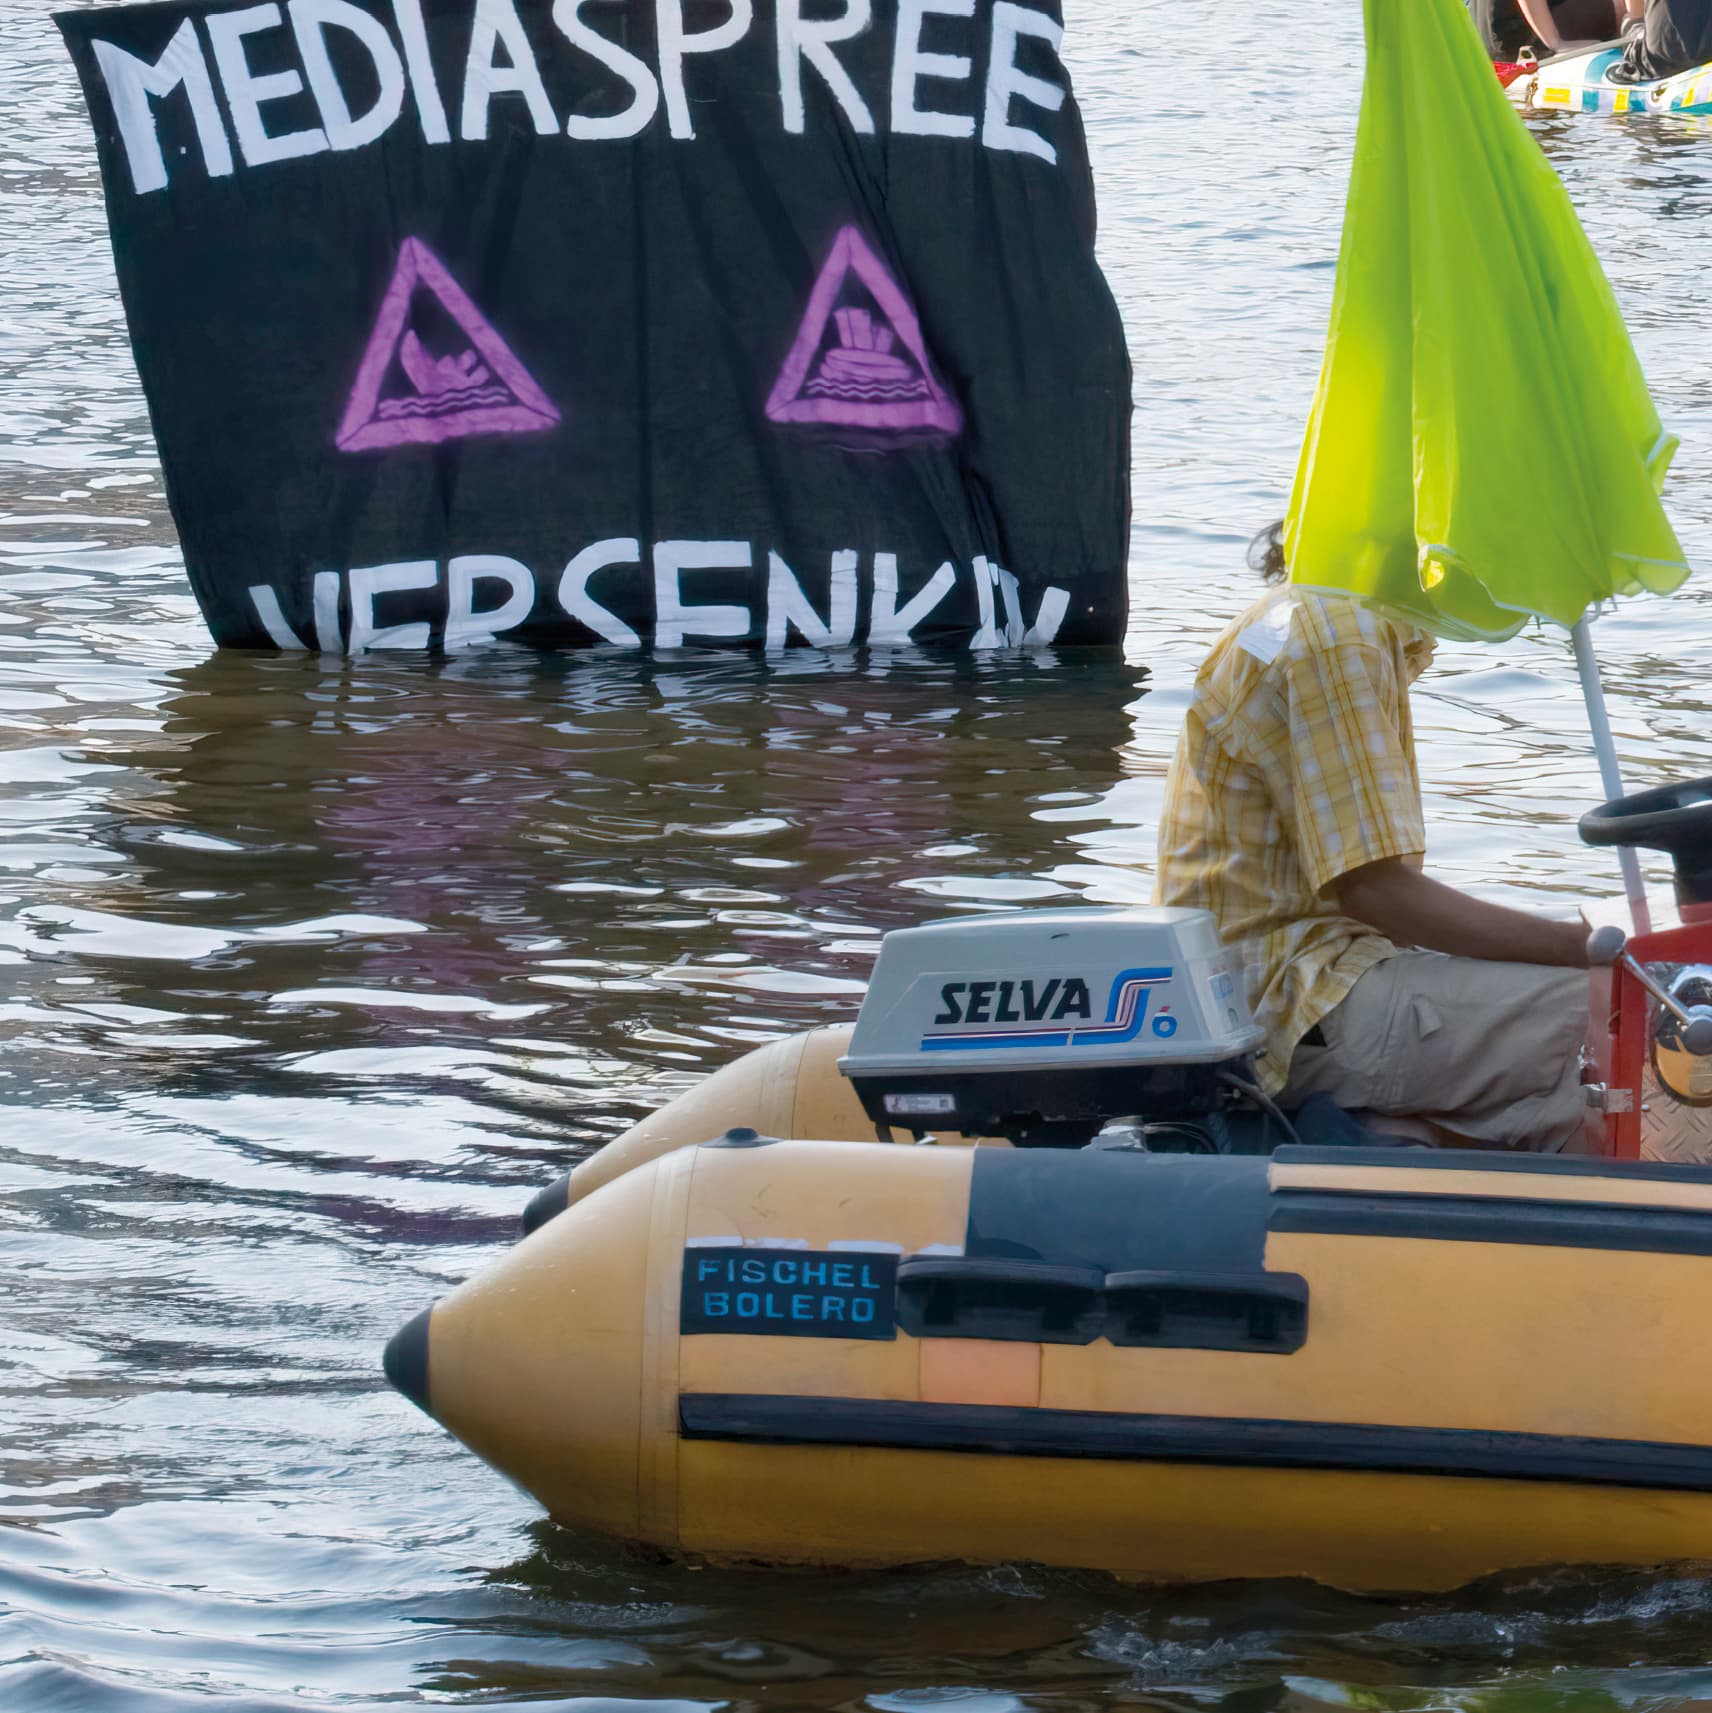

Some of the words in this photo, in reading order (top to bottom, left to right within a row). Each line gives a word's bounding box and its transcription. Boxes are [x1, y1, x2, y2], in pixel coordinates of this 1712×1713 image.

[934, 977, 1092, 1025] SELVA
[698, 1258, 881, 1289] FISCHEL
[703, 1291, 876, 1323] BOLERO
